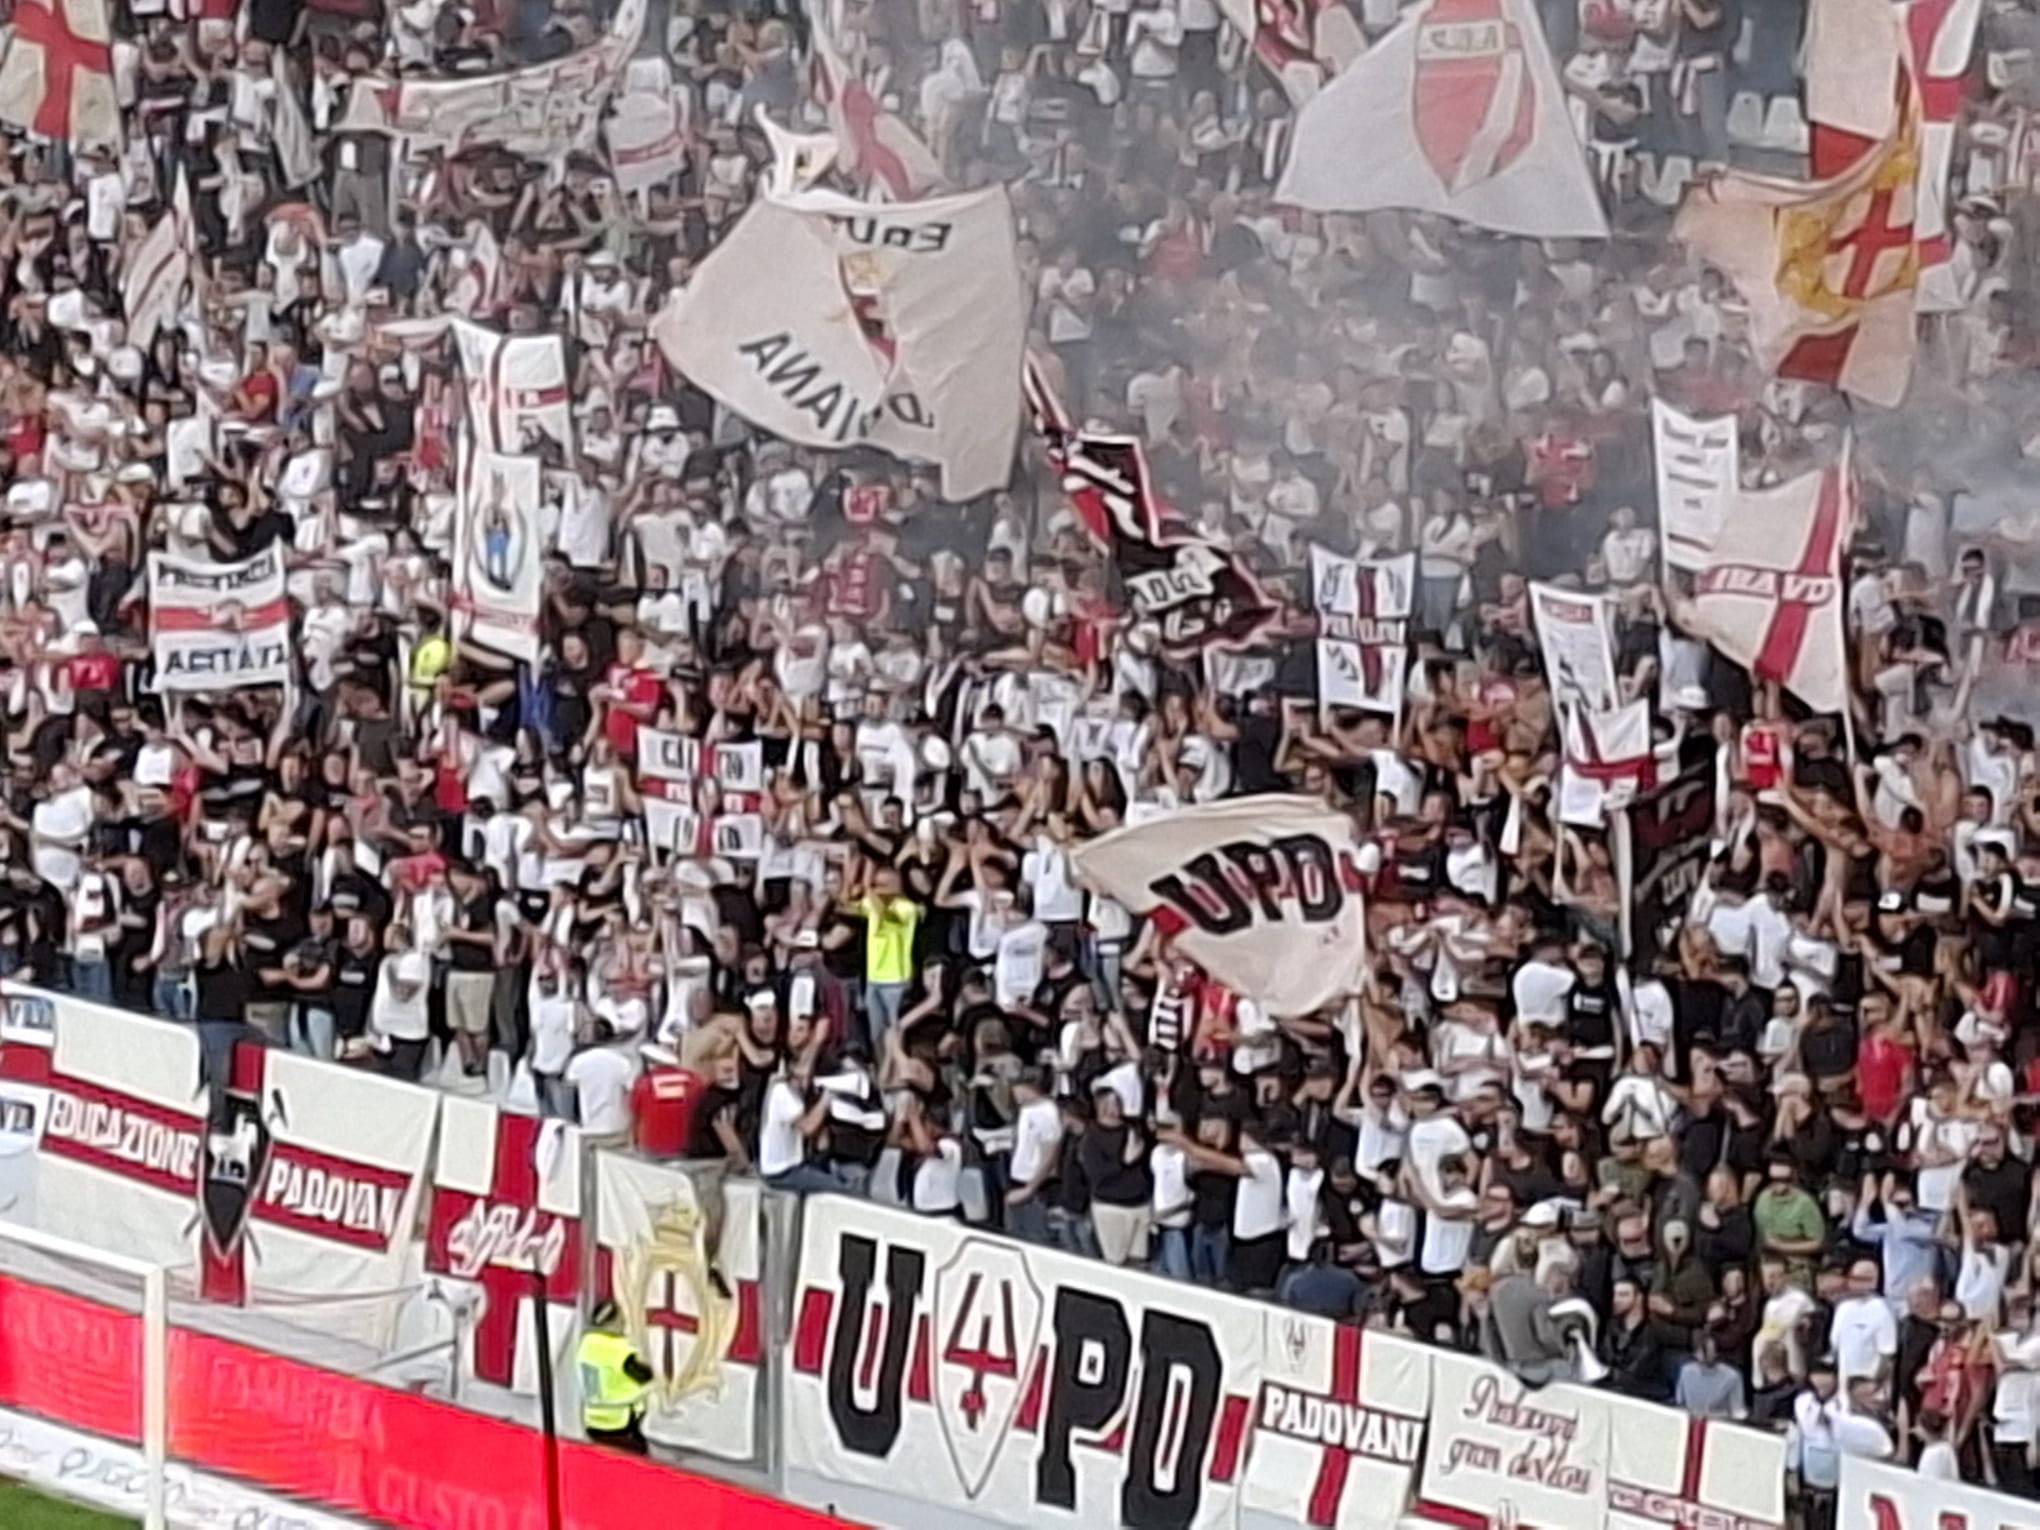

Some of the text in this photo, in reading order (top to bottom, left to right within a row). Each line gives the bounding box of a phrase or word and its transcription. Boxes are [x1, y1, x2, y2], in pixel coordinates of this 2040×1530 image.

[1149, 833, 1344, 935] UPD
[48, 1093, 200, 1182] EDUCAZIONE
[1262, 1385, 1424, 1462] PADOVANI
